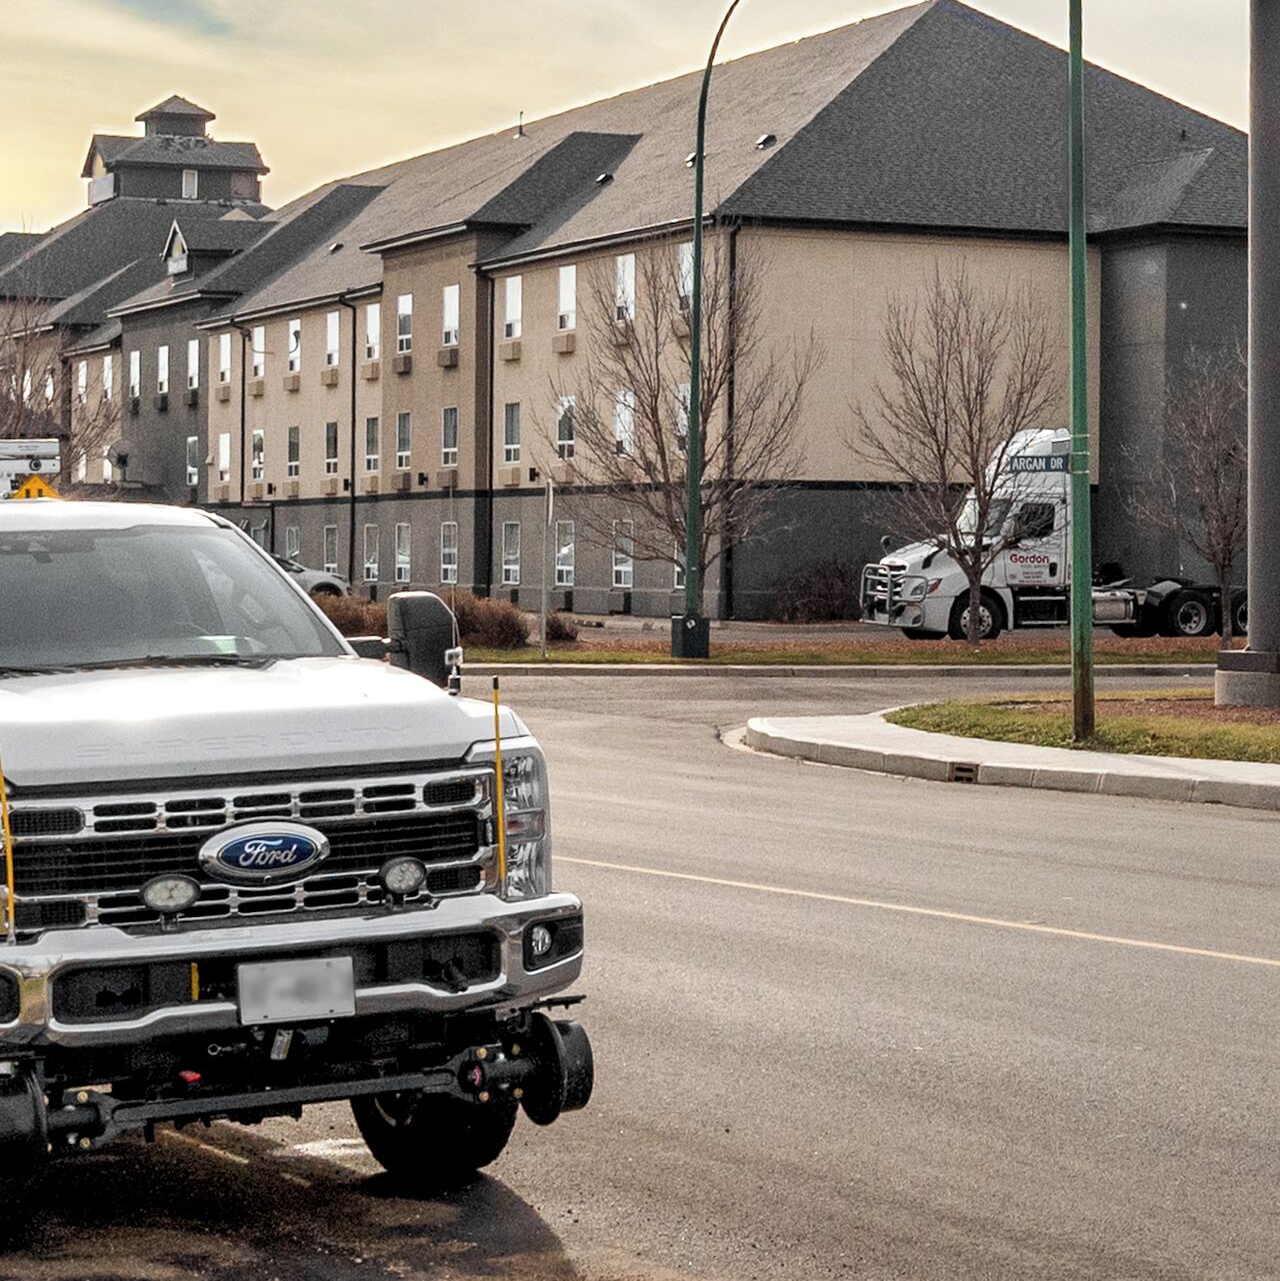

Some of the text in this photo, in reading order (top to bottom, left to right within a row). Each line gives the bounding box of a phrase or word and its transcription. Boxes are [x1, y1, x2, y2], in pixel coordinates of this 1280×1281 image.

[1012, 457, 1064, 471] ARGAN DR
[1010, 553, 1050, 564] Gordon
[239, 839, 298, 867] Ford
